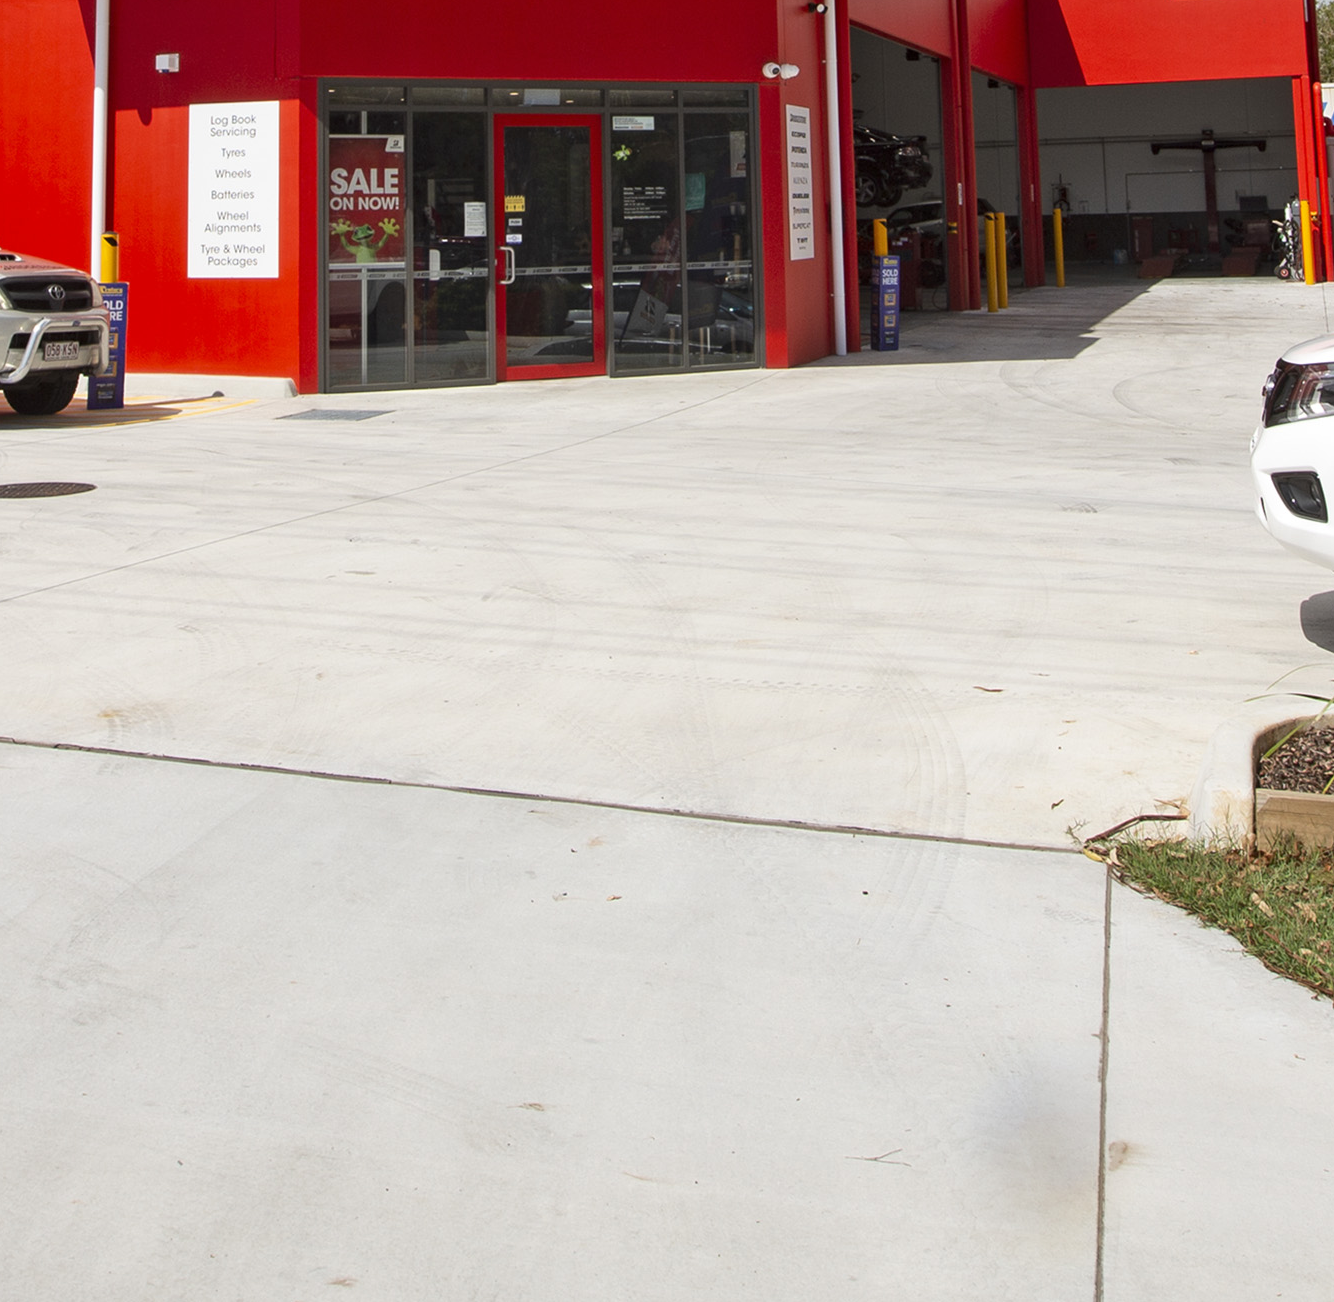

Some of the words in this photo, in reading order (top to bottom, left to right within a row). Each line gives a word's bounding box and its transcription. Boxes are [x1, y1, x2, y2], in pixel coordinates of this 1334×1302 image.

[210, 116, 228, 127] Log
[231, 115, 257, 125] Book
[210, 127, 257, 138] Servicing
[221, 148, 246, 159] Tyres
[215, 169, 252, 178] Wheels
[330, 167, 399, 195] SALE
[211, 190, 254, 200] Batteries
[330, 197, 354, 210] ON
[358, 197, 399, 210] NOW!
[216, 211, 249, 221] Wheel
[204, 223, 261, 235] Alignments
[200, 244, 220, 256] Tyre
[223, 245, 230, 254] &
[233, 244, 265, 254] Wheel
[207, 256, 258, 269] Packages
[103, 300, 123, 310] OLD
[109, 311, 123, 321] RE
